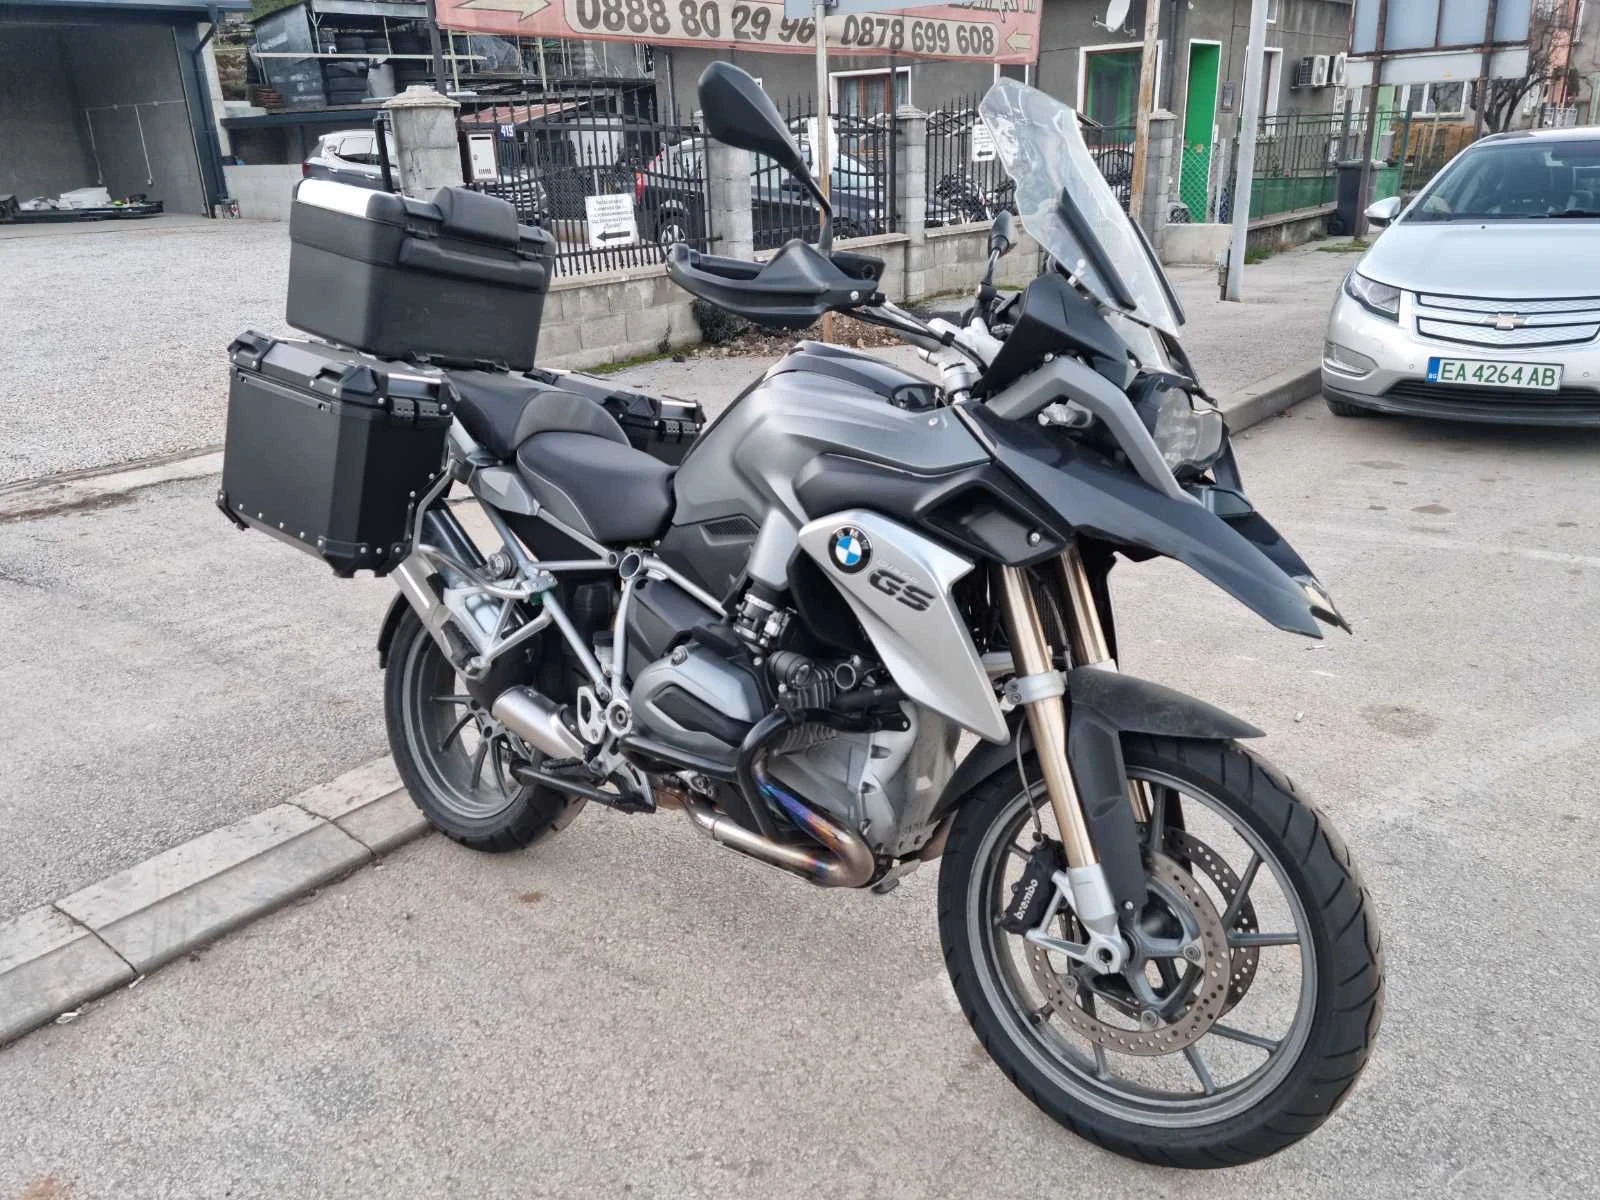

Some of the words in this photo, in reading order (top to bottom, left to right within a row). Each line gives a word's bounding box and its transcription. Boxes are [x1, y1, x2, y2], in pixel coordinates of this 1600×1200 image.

[577, 0, 671, 34] 0888
[679, 0, 721, 38] 80
[732, 5, 771, 41] 29
[841, 15, 904, 49] 0878
[912, 21, 950, 53] 699
[956, 25, 994, 55] 608
[501, 125, 514, 137] 419
[1441, 362, 1467, 381] EA
[1472, 365, 1523, 384] 4264
[1527, 368, 1556, 387] AB
[869, 569, 936, 611] GS
[1014, 879, 1038, 920] brembo
